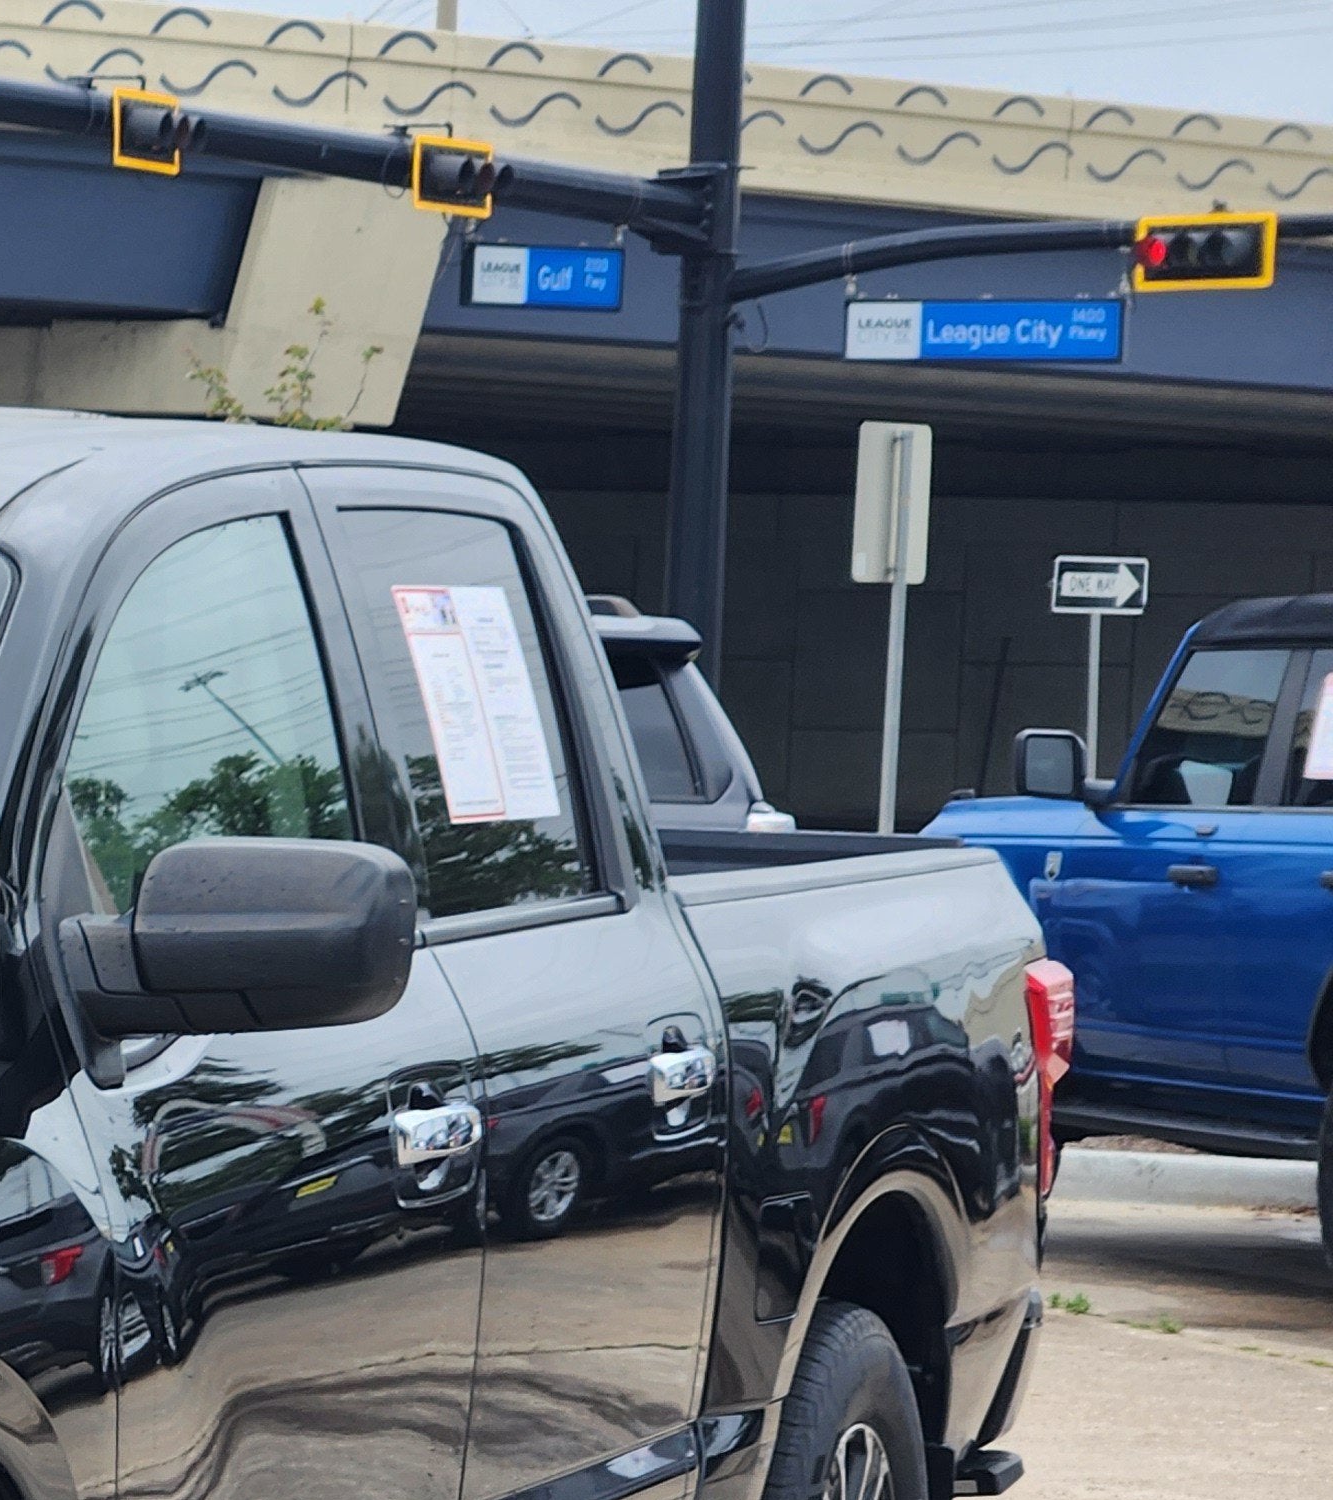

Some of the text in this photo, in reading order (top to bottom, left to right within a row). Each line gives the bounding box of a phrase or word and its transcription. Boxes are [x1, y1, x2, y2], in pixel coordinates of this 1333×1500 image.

[537, 264, 574, 291] Gulf
[857, 318, 912, 330] LEAGUE
[1068, 324, 1107, 342] Pkwy
[926, 318, 1011, 351] League
[1014, 318, 1063, 349] City
[1069, 575, 1091, 593] ONE
